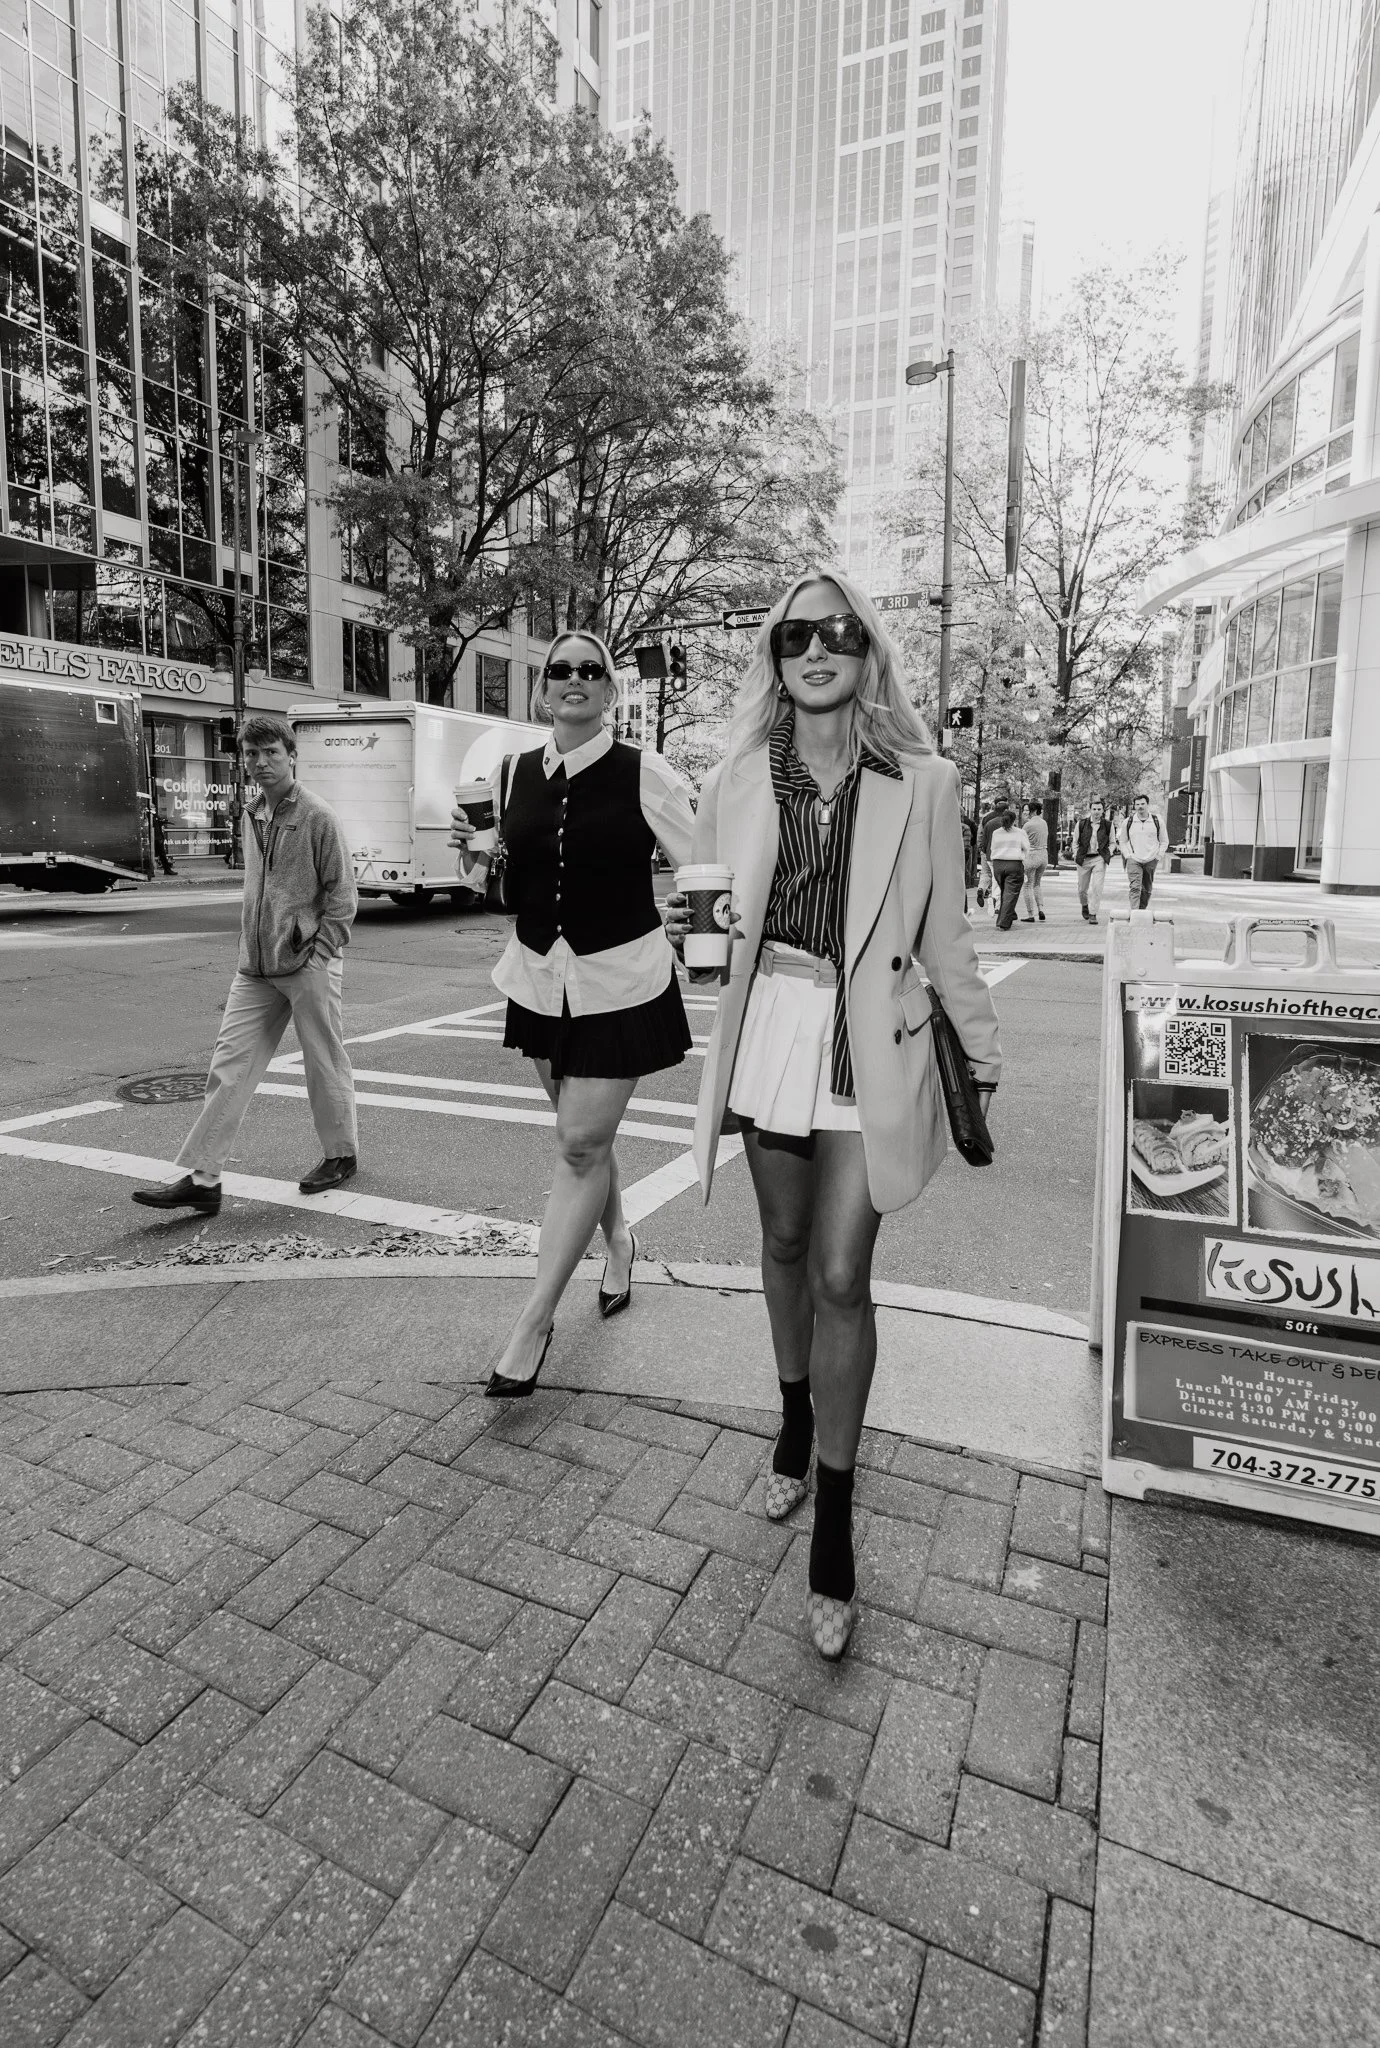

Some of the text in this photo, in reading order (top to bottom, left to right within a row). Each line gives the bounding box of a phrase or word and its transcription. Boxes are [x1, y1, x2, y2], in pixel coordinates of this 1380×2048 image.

[887, 596, 909, 609] 3RD
[920, 592, 929, 600] ST
[736, 615, 750, 623] ONE
[0, 640, 207, 694] ELLS FARGO
[154, 744, 171, 754] 301
[324, 736, 364, 747] aramark
[163, 778, 201, 793] Could
[203, 783, 233, 798] your
[174, 796, 227, 811] be more
[1284, 1320, 1319, 1335] 50ft
[1139, 1332, 1225, 1355] EXPRESS
[1228, 1346, 1281, 1365] TAKE
[1286, 1356, 1328, 1373] OUT
[1263, 1370, 1313, 1388] Hours
[1176, 1378, 1377, 1423] Lunch 11:00 AM to 3:00
[1221, 1374, 1284, 1397] Monday
[1304, 1389, 1359, 1410] Friday
[1179, 1390, 1374, 1434] Dinner 4:30 PM to 9:00
[1182, 1402, 1234, 1420] Closed
[1242, 1413, 1316, 1438] Saturday
[1324, 1428, 1335, 1440] &
